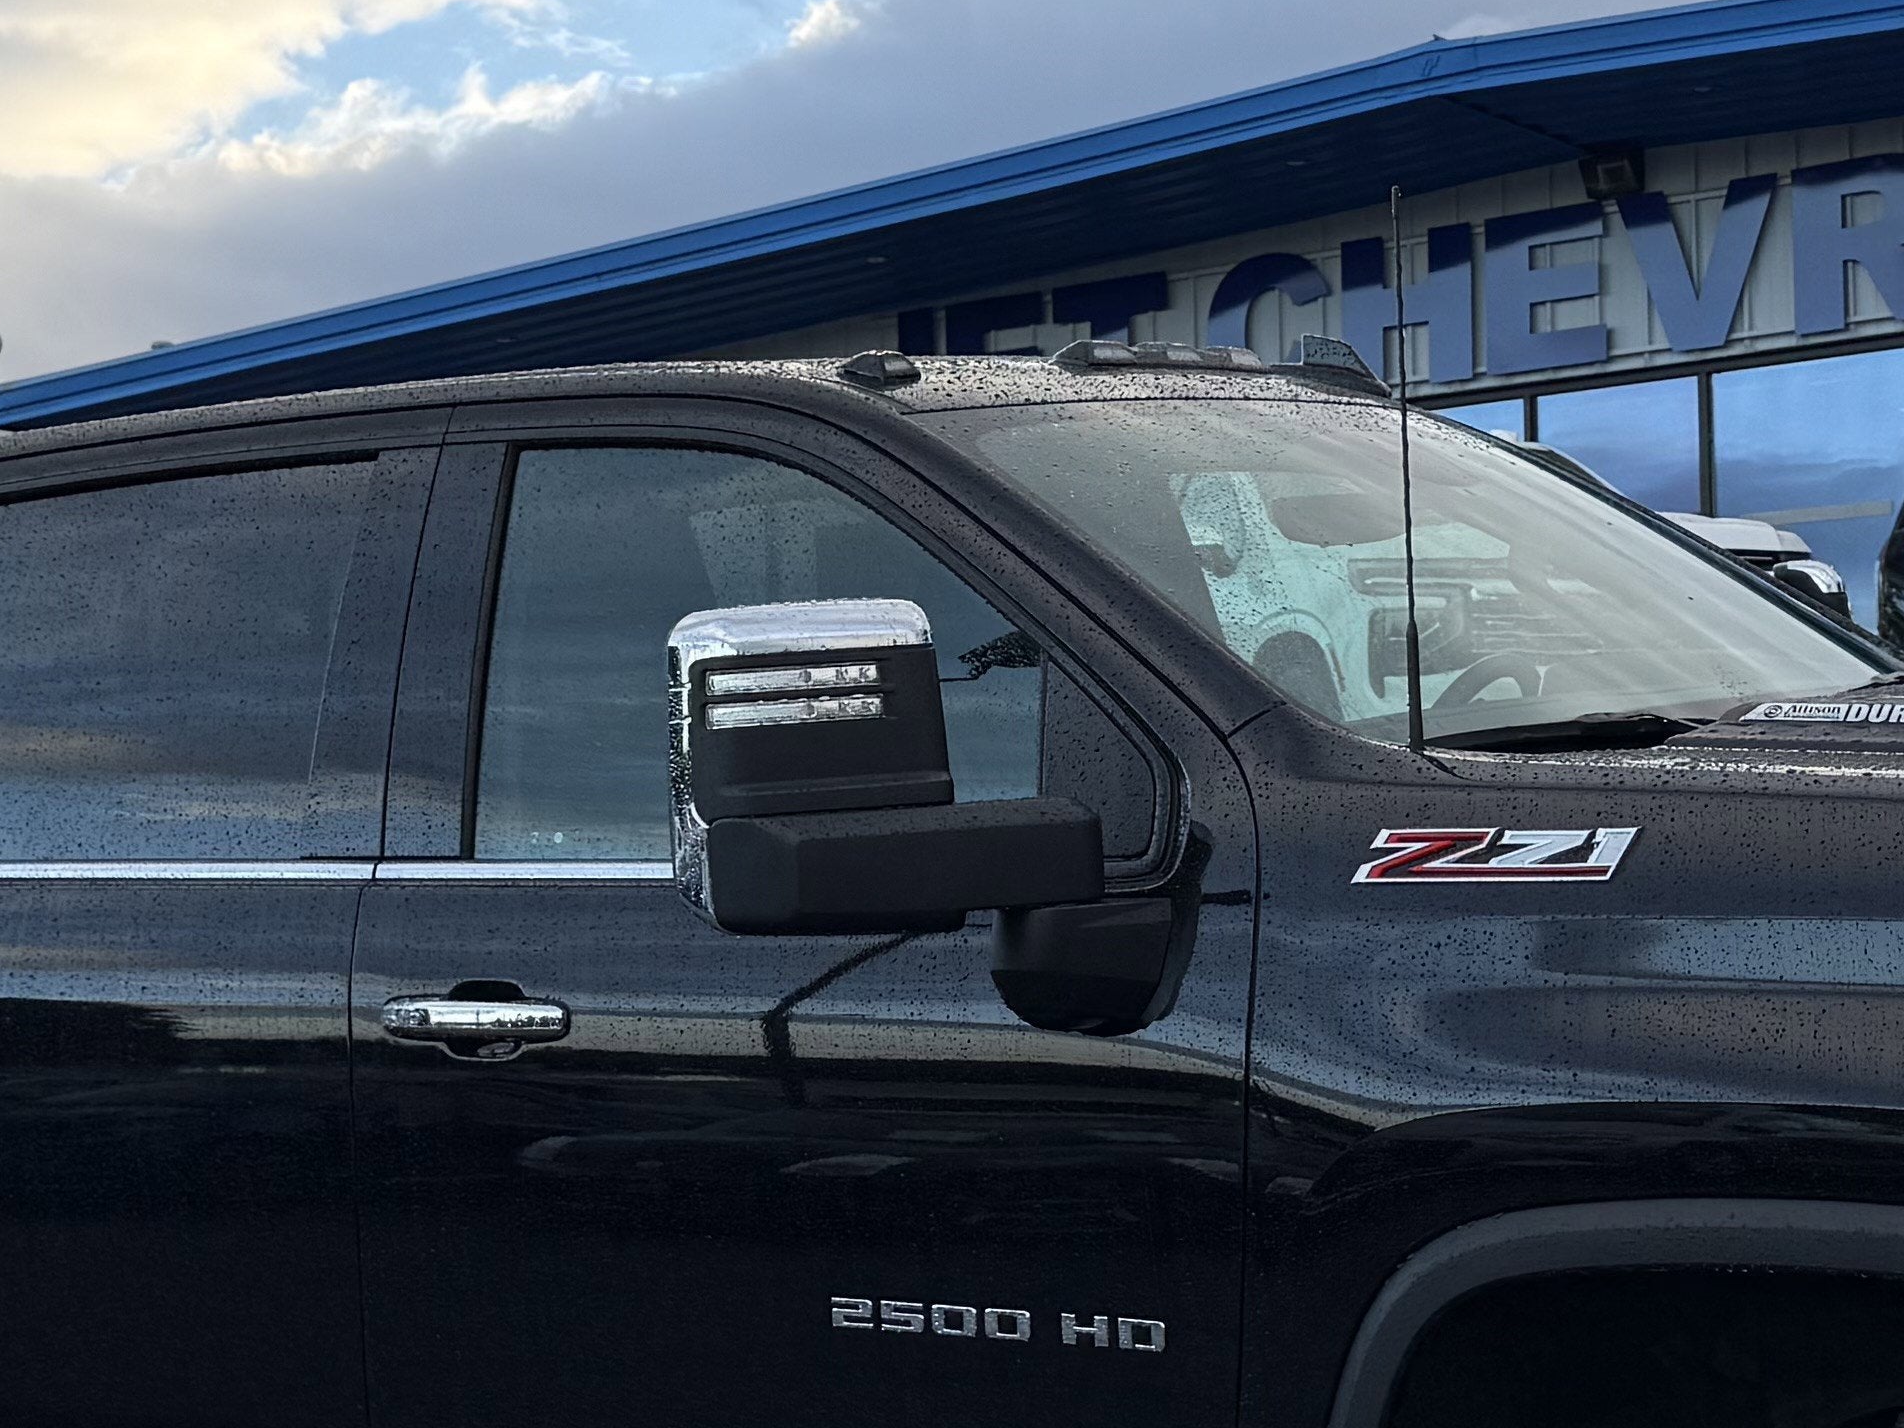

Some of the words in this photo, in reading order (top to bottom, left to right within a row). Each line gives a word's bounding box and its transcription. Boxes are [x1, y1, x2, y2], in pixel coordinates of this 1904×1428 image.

[1783, 704, 1842, 718] Allison
[1350, 826, 1644, 884] Z71
[831, 1297, 1031, 1342] 2500
[1061, 1313, 1166, 1352] HD
